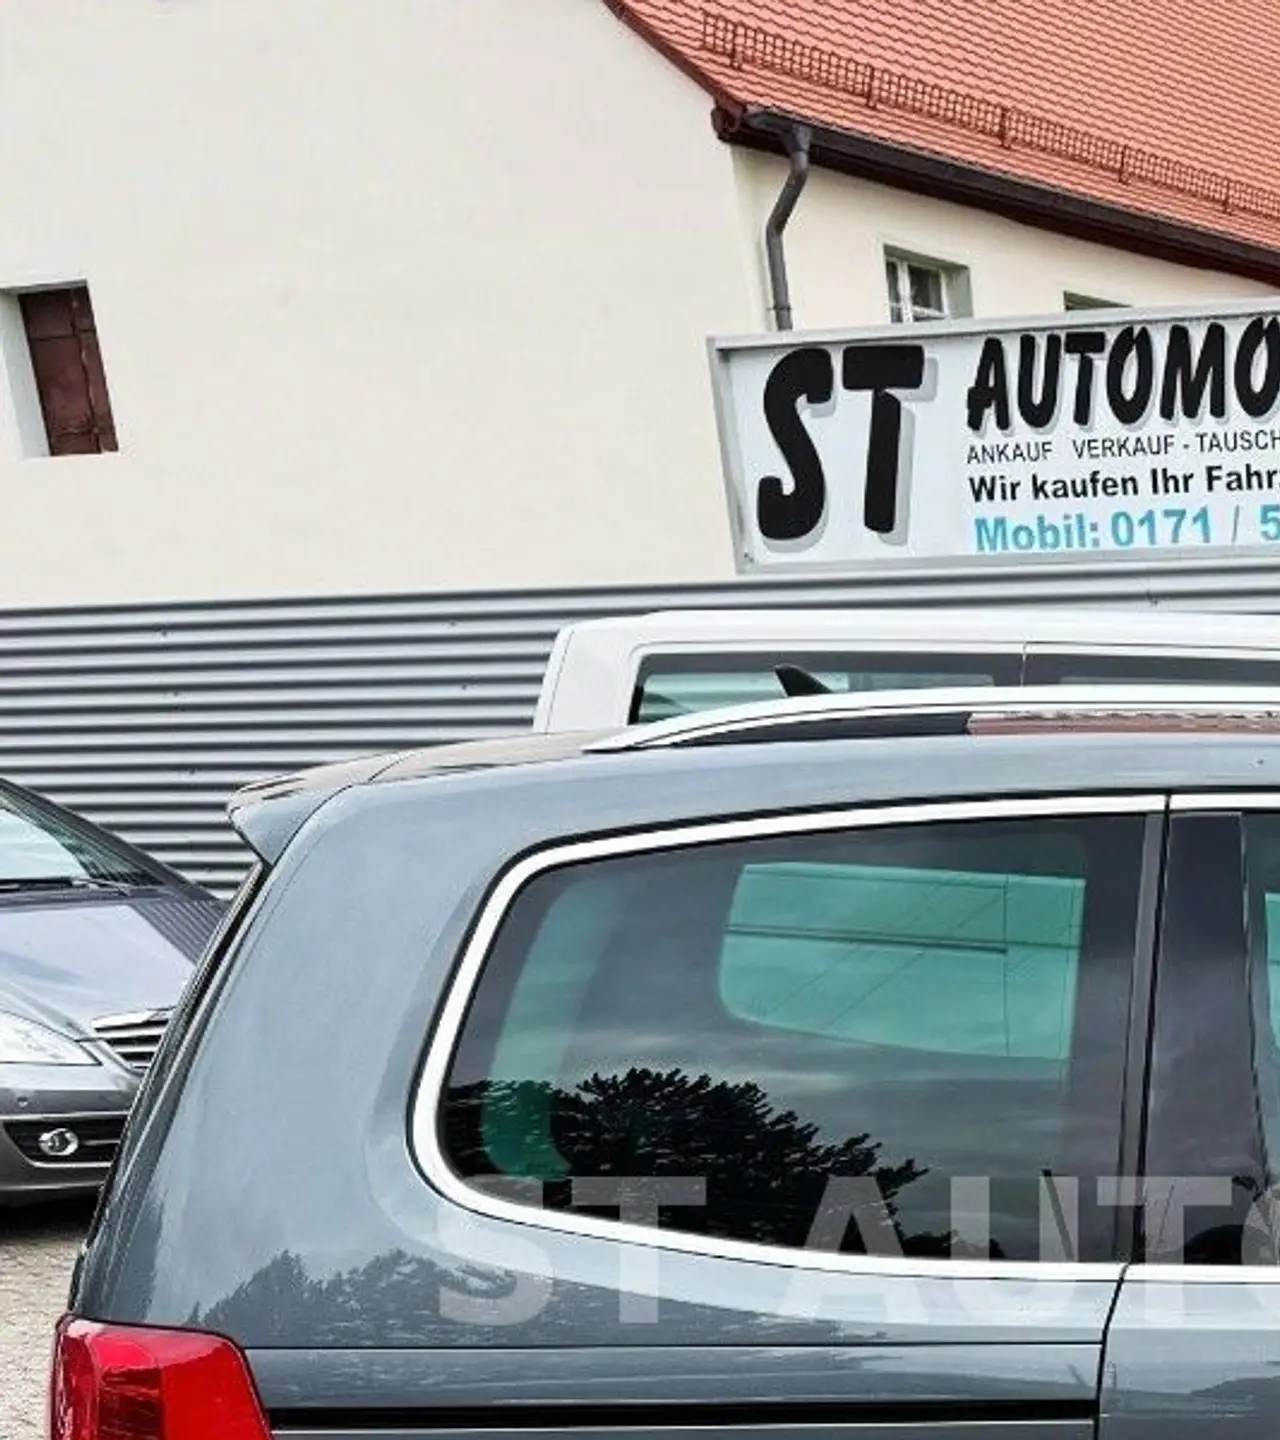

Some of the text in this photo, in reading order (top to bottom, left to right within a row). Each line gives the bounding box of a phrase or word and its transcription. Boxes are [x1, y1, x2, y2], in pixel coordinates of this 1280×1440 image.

[756, 342, 925, 540] ST
[966, 441, 1054, 465] ANKAUF
[1072, 435, 1176, 460] VERKAUF
[968, 473, 1021, 502] Wir
[1031, 468, 1140, 499] kaufen
[1151, 466, 1195, 495] Ihr
[974, 513, 1099, 552] Mobil:
[1111, 507, 1213, 548] 0171
